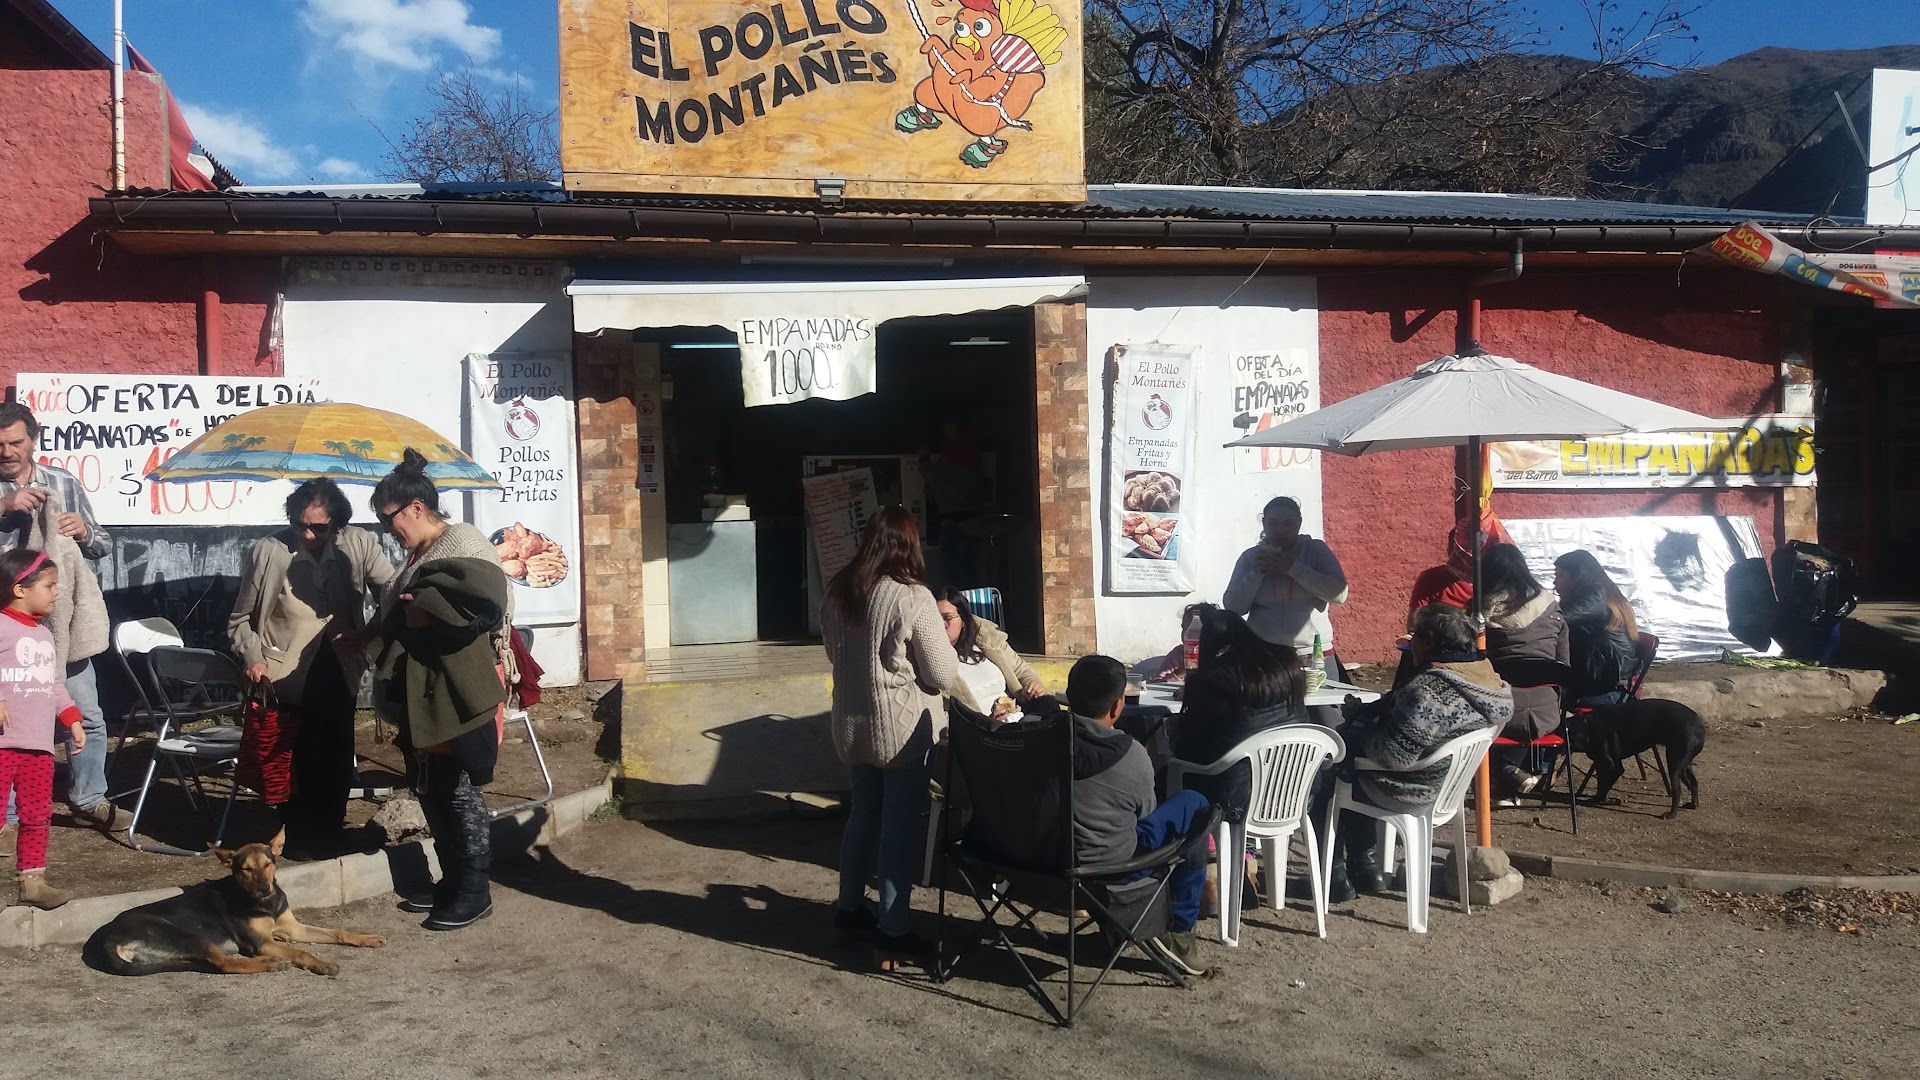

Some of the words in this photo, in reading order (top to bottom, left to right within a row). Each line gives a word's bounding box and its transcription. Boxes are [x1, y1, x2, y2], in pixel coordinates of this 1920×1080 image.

[629, 21, 690, 81] EL
[698, 0, 888, 77] POLLO
[635, 41, 897, 144] MONTAÑÉS
[743, 318, 870, 346] EMPANADAS
[815, 341, 842, 350] HORNO
[487, 364, 504, 378] El
[511, 362, 551, 378] Pollo
[1139, 362, 1149, 372] El
[1153, 362, 1180, 374] Pollo
[1237, 355, 1283, 371] OFERTA
[1254, 370, 1273, 380] DEL
[1277, 363, 1303, 377] DÍA
[1132, 376, 1186, 388] Montañés
[216, 384, 269, 406] DEL
[480, 382, 564, 399] Montañés
[1235, 381, 1309, 412] EMPANADAS
[1273, 402, 1305, 416] HORNO
[175, 427, 193, 437] DE
[1128, 437, 1178, 448] Empanadas
[1560, 425, 1818, 476] EMPANADAS
[499, 446, 550, 463] Pollos
[1136, 448, 1164, 457] Fritas
[1166, 451, 1171, 459] y
[1140, 458, 1167, 467] Horno
[508, 466, 564, 485] Papas
[1525, 470, 1559, 480] Barrio
[500, 486, 558, 502] Fritas
